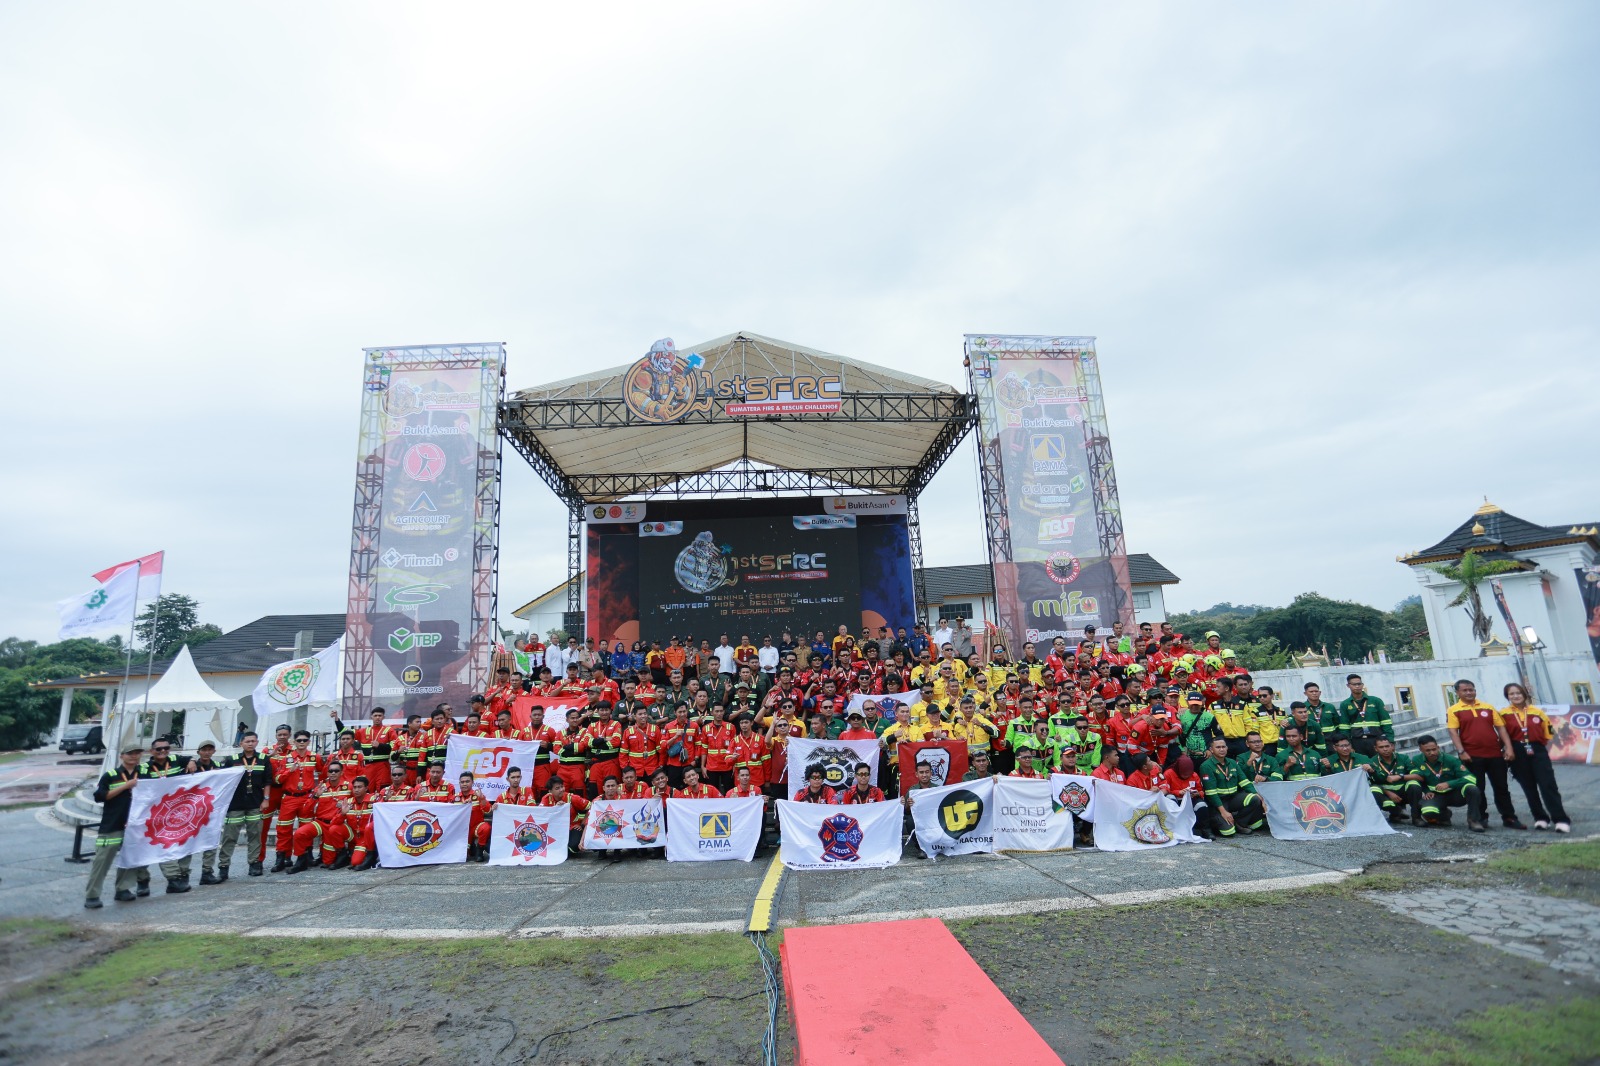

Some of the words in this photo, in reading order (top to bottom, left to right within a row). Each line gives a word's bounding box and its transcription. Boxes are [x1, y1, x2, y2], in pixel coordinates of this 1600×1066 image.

[1033, 461, 1068, 471] PAMA
[394, 515, 451, 525] AGINCOURT
[404, 554, 444, 567] Timah
[660, 602, 709, 610] SUMATERA
[415, 633, 442, 647] TBP
[1040, 630, 1064, 641] golden
[405, 686, 443, 694] TRACTORS
[486, 782, 510, 790] Solutio
[699, 840, 732, 849] PAMA
[957, 836, 993, 845] RACTORS
[831, 846, 850, 854] RESCUE
